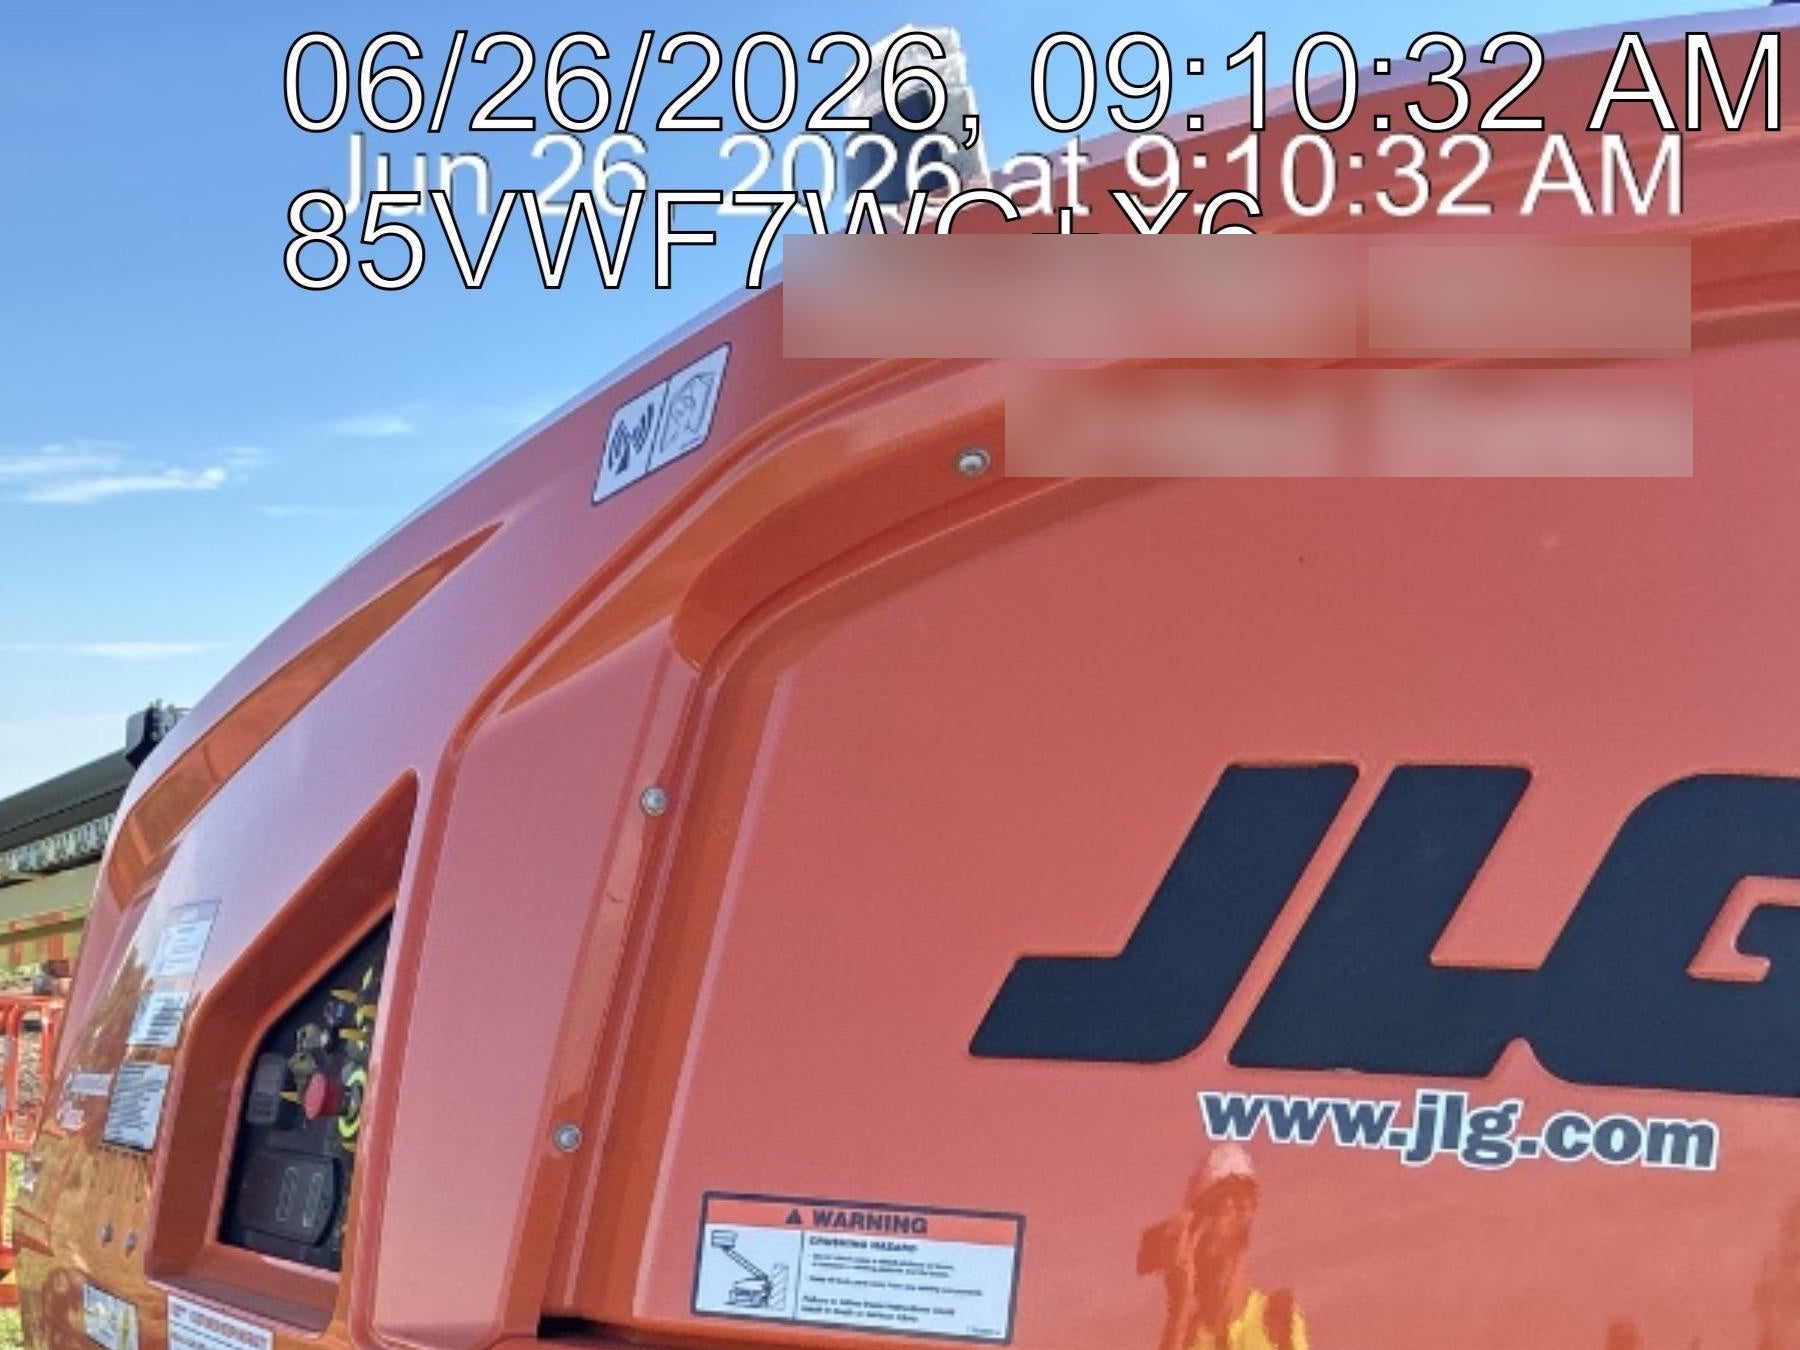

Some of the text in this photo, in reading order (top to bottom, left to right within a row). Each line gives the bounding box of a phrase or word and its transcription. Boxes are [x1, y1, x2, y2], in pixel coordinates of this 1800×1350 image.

[967, 763, 1800, 1096] JLG
[1198, 1090, 1720, 1170] www.jlg.com
[812, 1209, 928, 1234] WARNING
